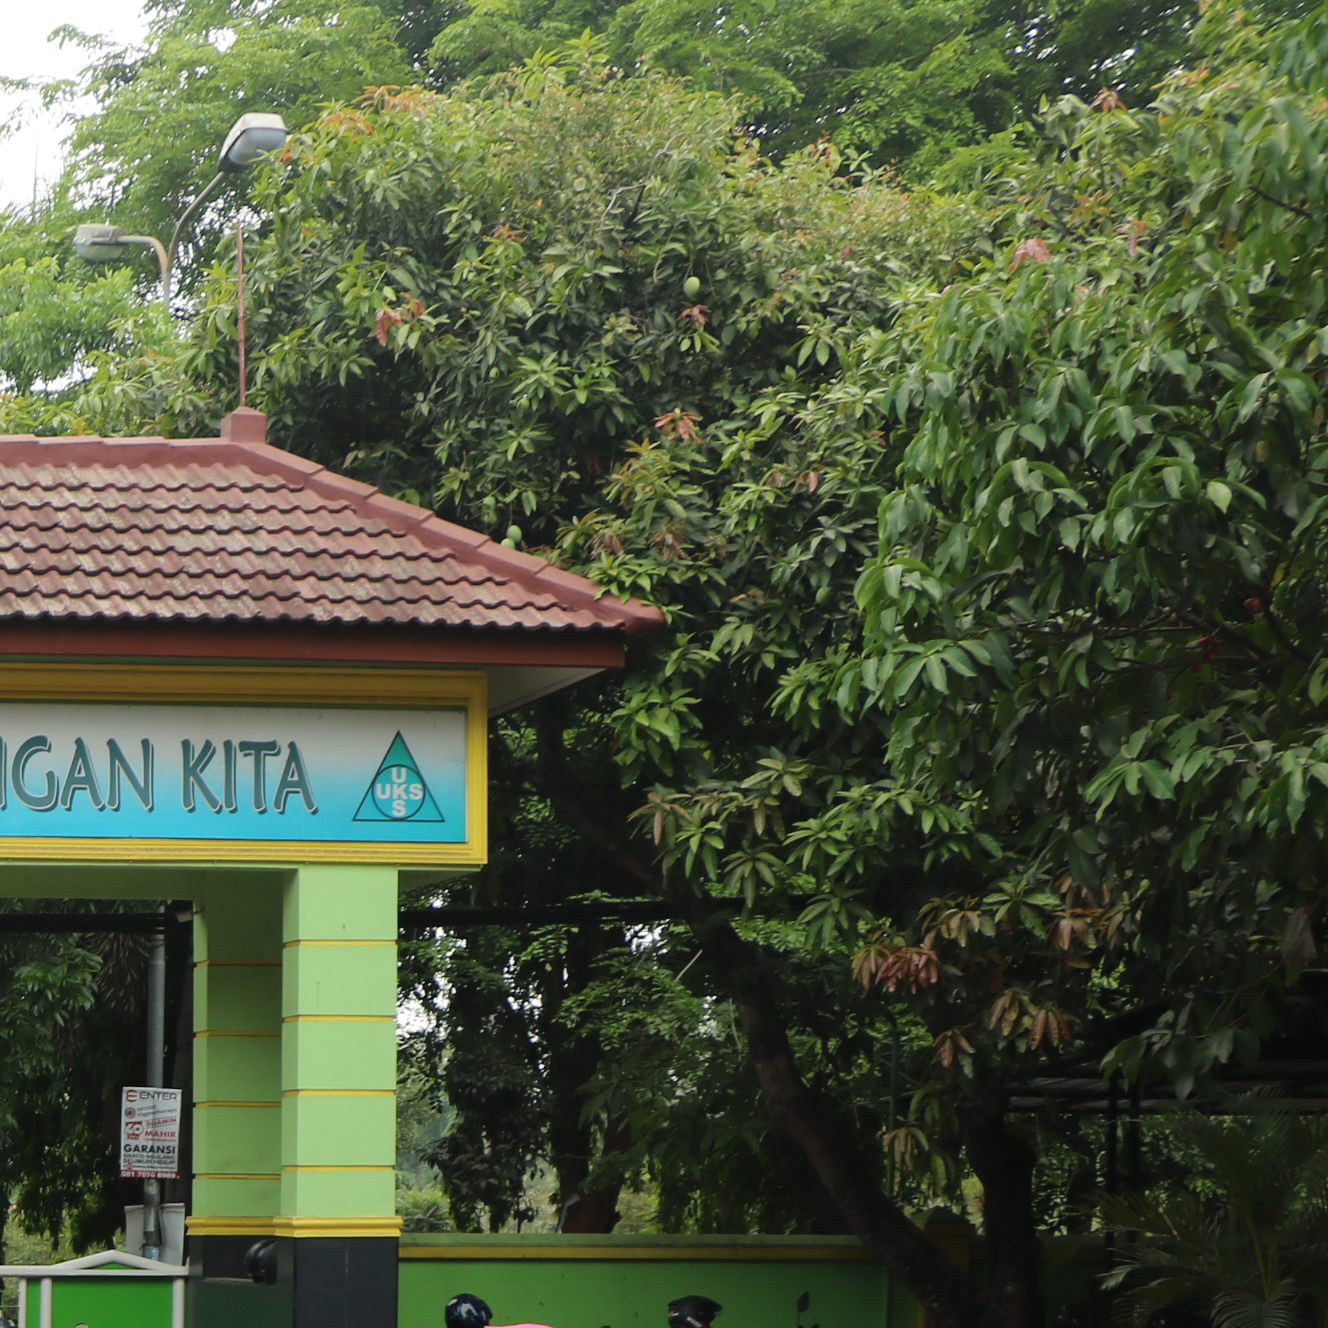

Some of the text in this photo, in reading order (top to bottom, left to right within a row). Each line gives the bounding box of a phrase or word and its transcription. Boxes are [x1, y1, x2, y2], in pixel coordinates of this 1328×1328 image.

[180, 737, 320, 815] KITA
[376, 782, 424, 800] UKS
[139, 1091, 178, 1101] ENTER
[145, 1130, 177, 1138] MAHIR
[123, 1144, 176, 1155] GARANSI
